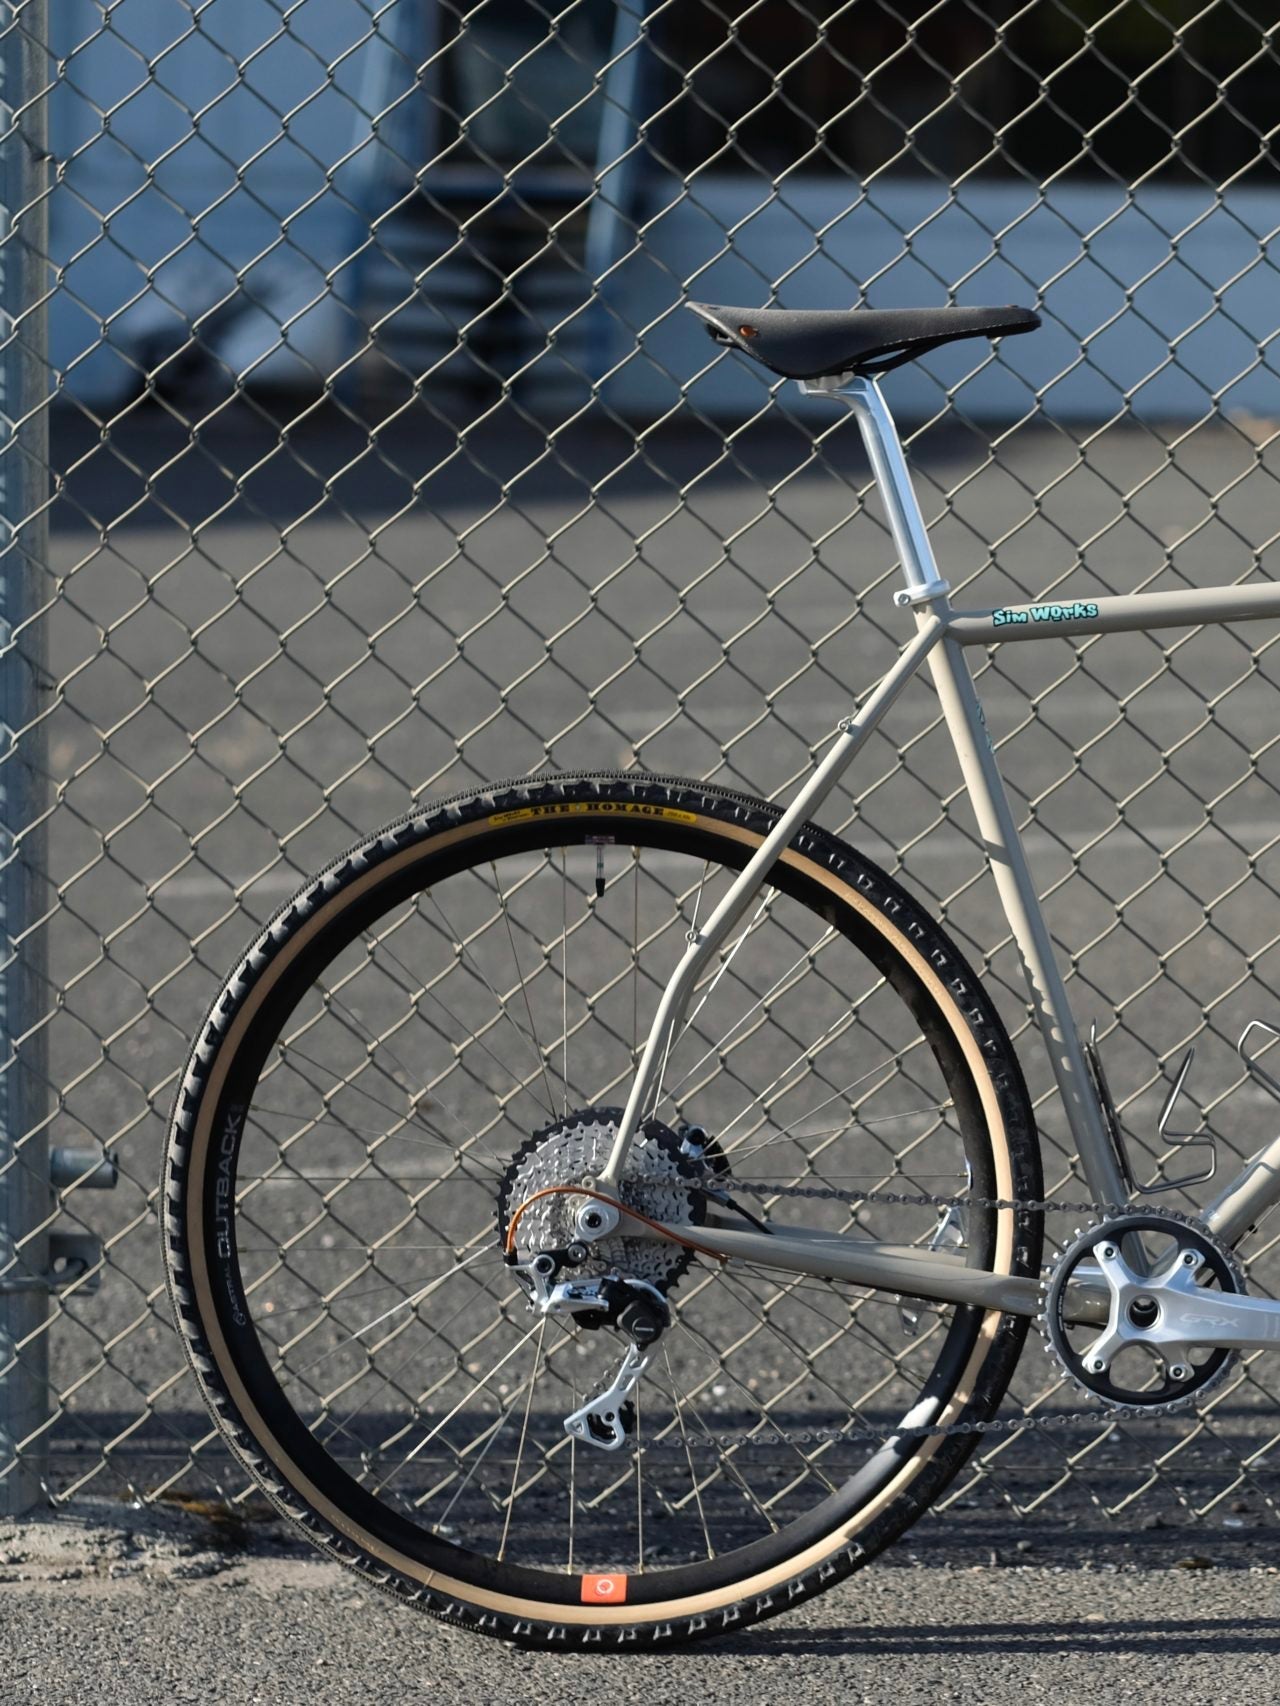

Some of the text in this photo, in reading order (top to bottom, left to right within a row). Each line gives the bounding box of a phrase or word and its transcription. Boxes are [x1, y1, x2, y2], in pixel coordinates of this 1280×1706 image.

[531, 803, 570, 817] THE
[587, 802, 664, 816] HOMAGE
[215, 1113, 242, 1259] OUTBACK
[1179, 1312, 1239, 1328] GRX
